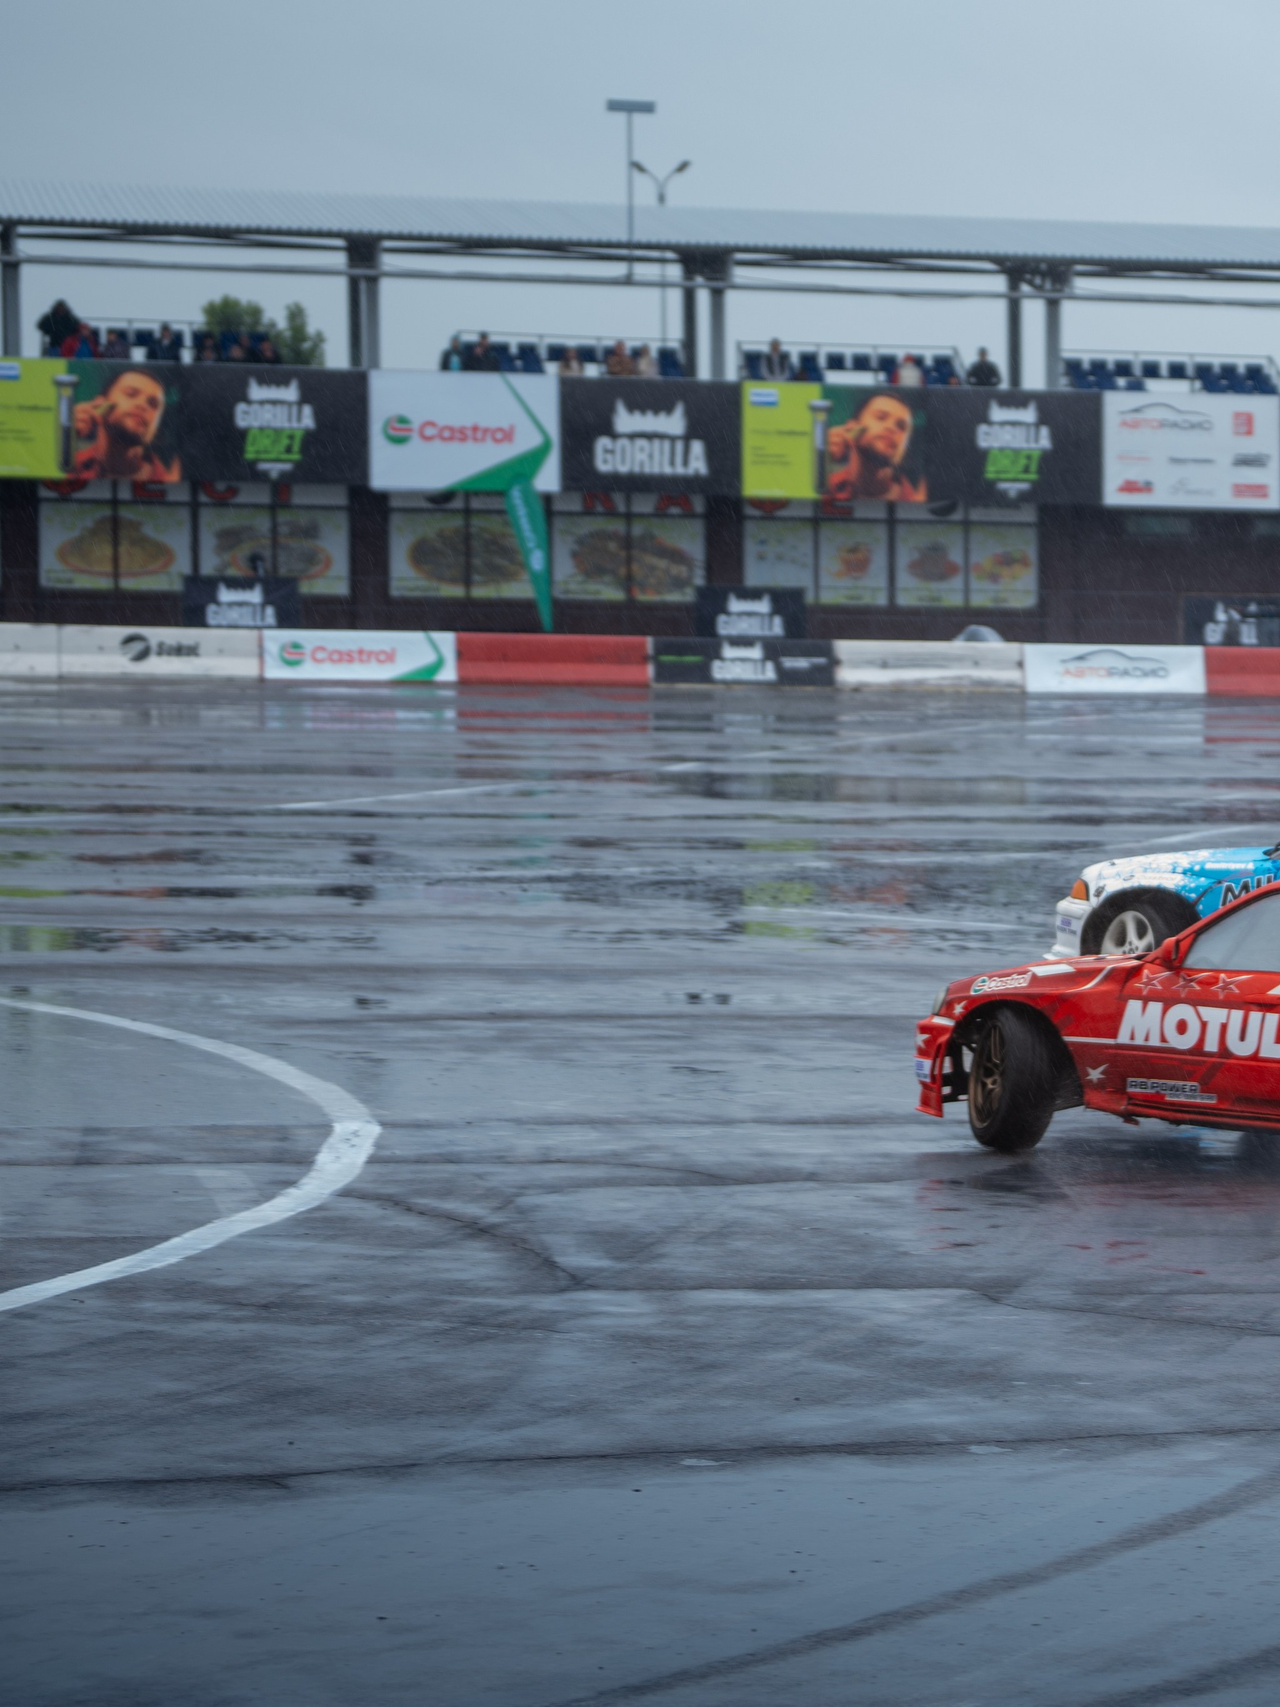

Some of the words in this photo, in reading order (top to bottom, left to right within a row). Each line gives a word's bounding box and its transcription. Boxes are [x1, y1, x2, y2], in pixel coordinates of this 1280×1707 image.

[235, 402, 315, 429] GORILLA
[418, 420, 515, 444] Castrol
[977, 423, 1052, 450] GORILLA
[594, 435, 709, 475] GORILLA
[984, 449, 1042, 481] DRIFT
[206, 603, 278, 627] GORILLA
[716, 613, 785, 637] GORILLA
[310, 646, 396, 665] Castrol
[711, 658, 778, 681] GORILLA
[986, 972, 1032, 991] Castrol
[1150, 1082, 1198, 1093] POWER
